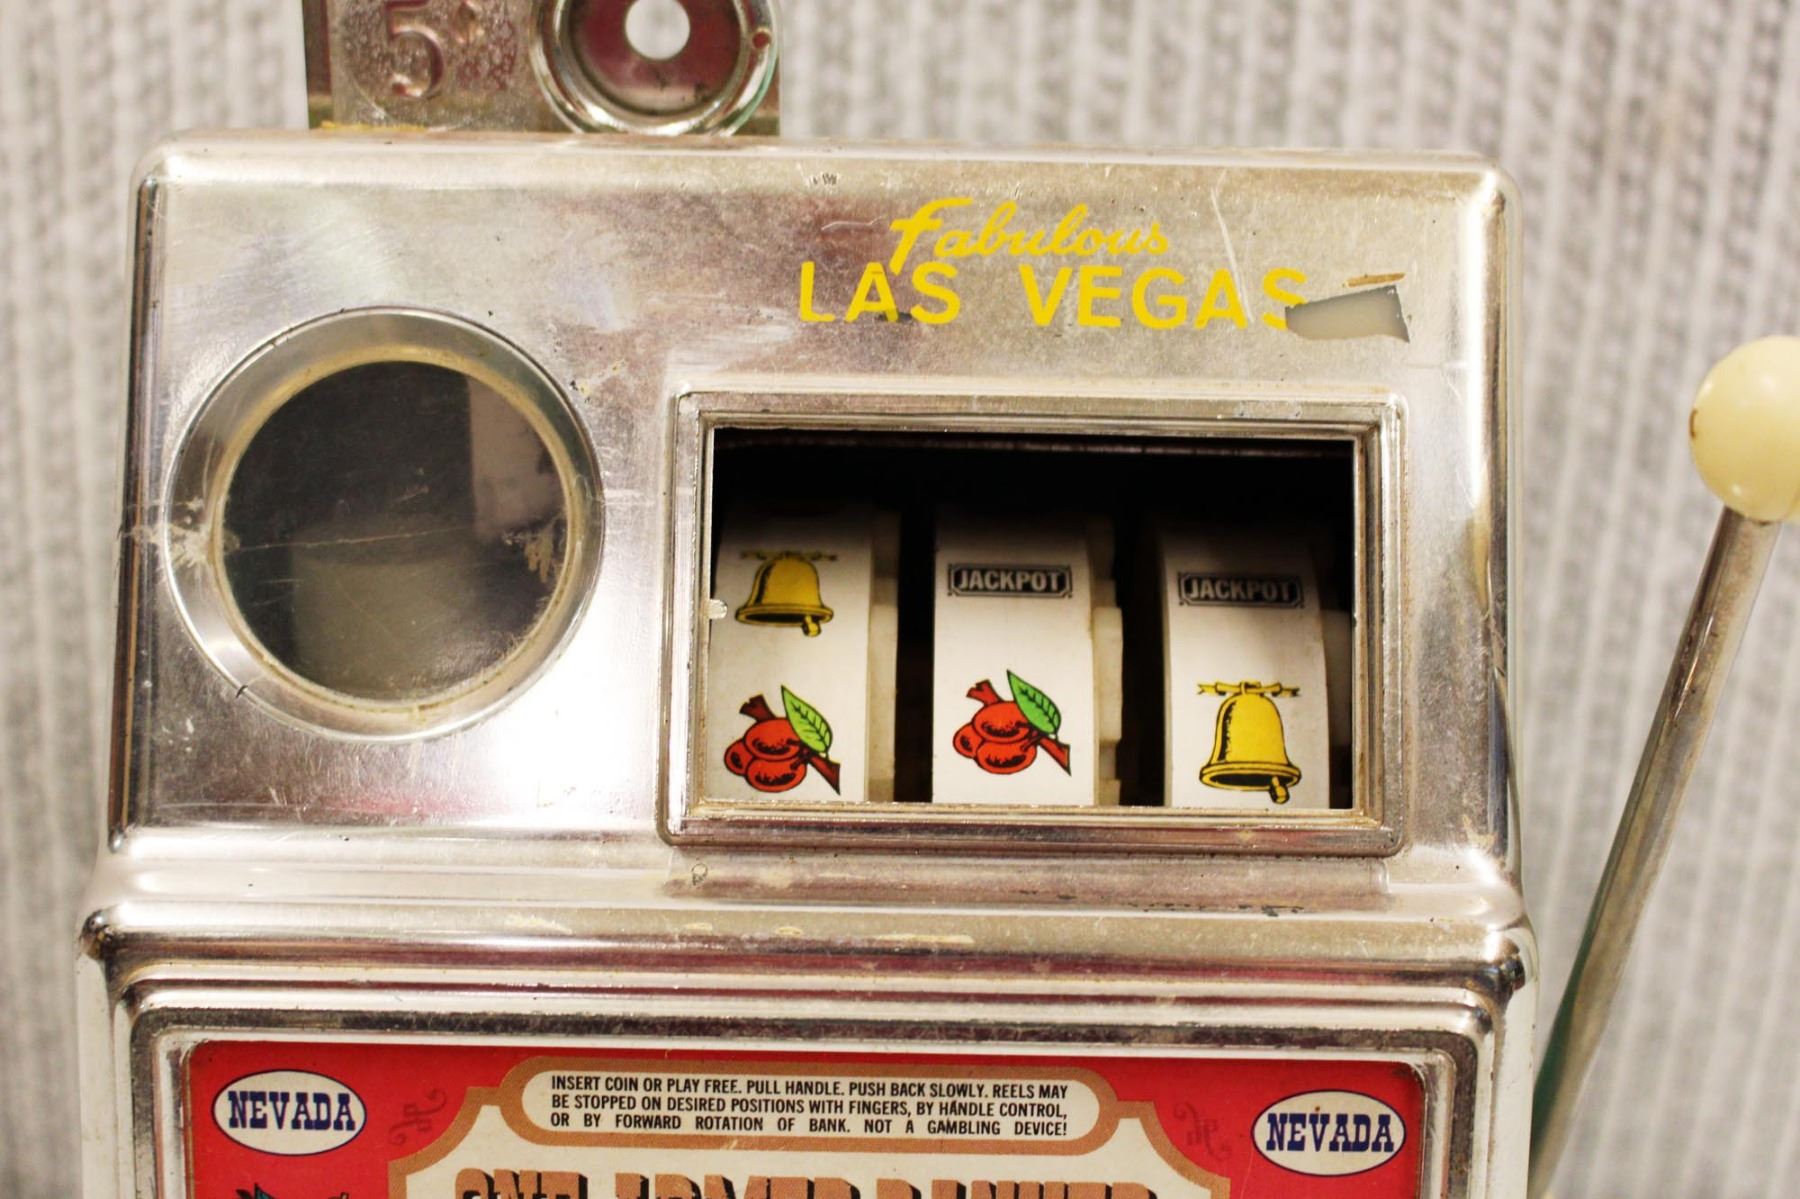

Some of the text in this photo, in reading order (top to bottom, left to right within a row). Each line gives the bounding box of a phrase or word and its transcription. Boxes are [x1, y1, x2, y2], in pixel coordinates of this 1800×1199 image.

[799, 261, 1309, 331] LAS VEGAS
[958, 569, 1062, 592] JACKPOT
[1187, 577, 1296, 602] JACKPOT
[551, 1075, 1068, 1101] INSERT COIN OR PLAY FREE. PULL HANDLE. PUSH BACK SLOWLY. REELS MAY
[227, 1090, 356, 1131] NEVADA
[552, 1093, 1067, 1121] BE STOPPED ON DESIRED POSITIONS WITH FINGERS, BY HANDLE CONTROL,
[550, 1112, 1067, 1137] OR BY FORWARD ROTATION OF BANK. NOT A GAMBLING DEVICE!
[1265, 1113, 1395, 1153] NEVADA
